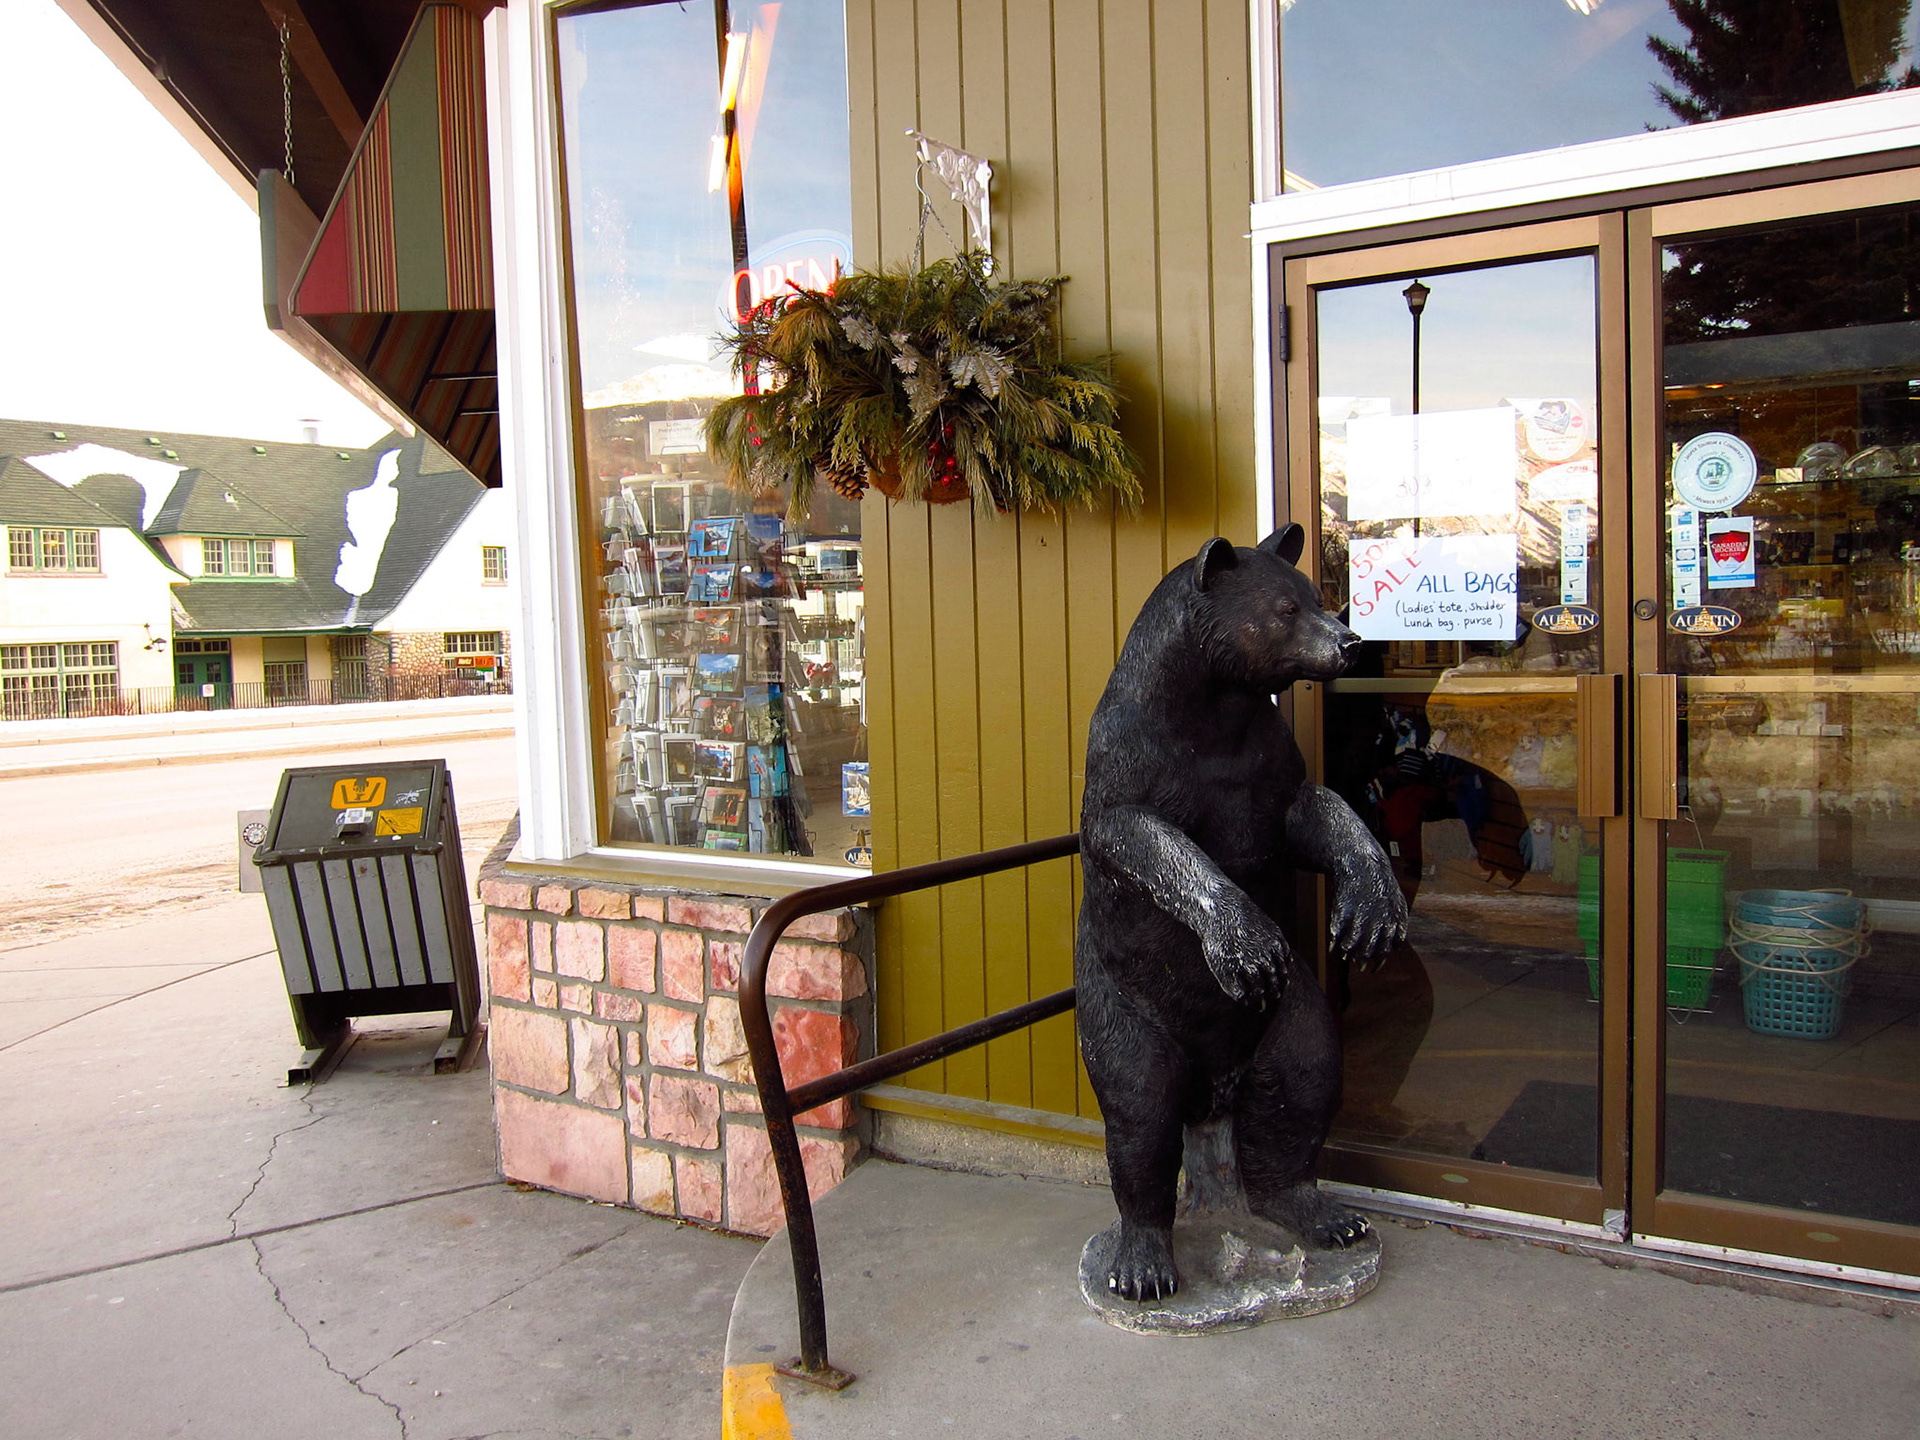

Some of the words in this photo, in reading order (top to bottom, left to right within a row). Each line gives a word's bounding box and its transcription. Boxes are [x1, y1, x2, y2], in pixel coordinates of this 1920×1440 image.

[727, 253, 841, 324] OPEN
[1711, 541, 1748, 549] CANADIAN
[1352, 549, 1422, 617] SALE
[1416, 574, 1455, 593] ALL
[1464, 571, 1518, 594] BAGS
[1403, 617, 1433, 629] Lunch
[1539, 614, 1596, 626] AUSTIN
[1675, 614, 1736, 627] AUSTIN
